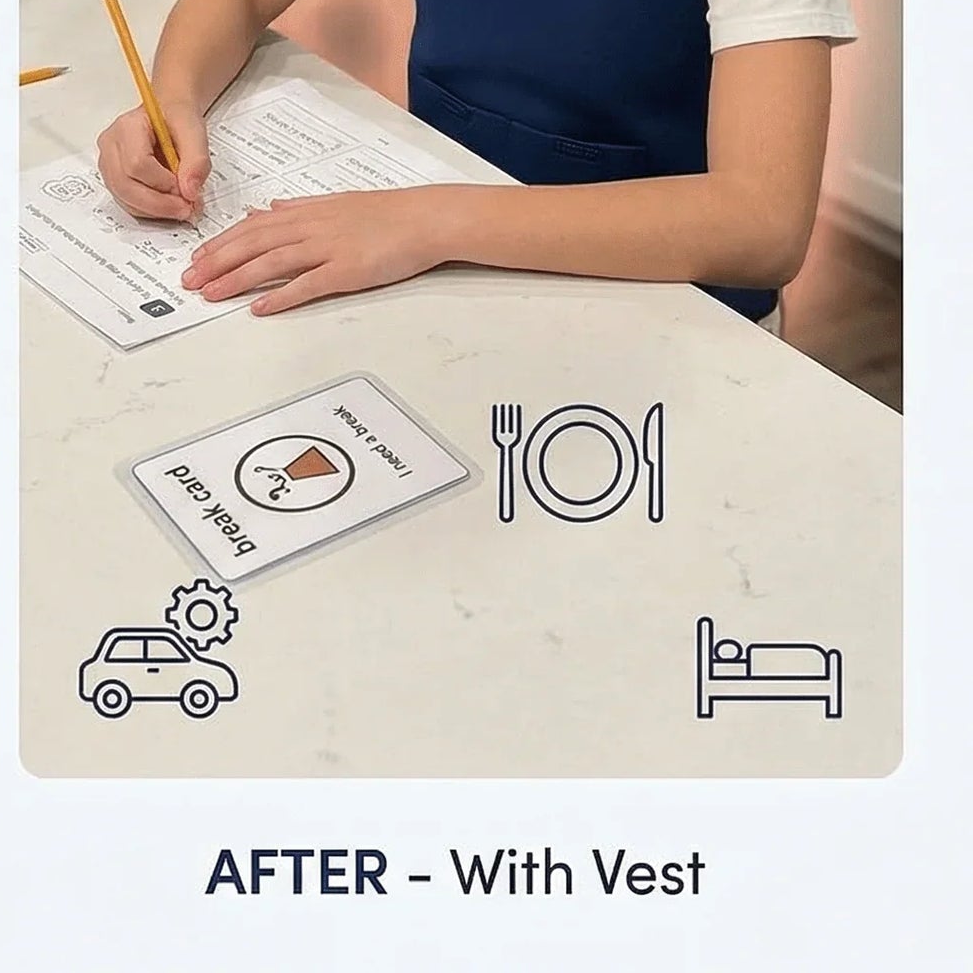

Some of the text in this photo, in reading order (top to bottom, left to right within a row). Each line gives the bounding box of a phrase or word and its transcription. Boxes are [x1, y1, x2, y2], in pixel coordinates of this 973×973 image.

[332, 404, 414, 479] I need a break
[163, 465, 258, 558] break card
